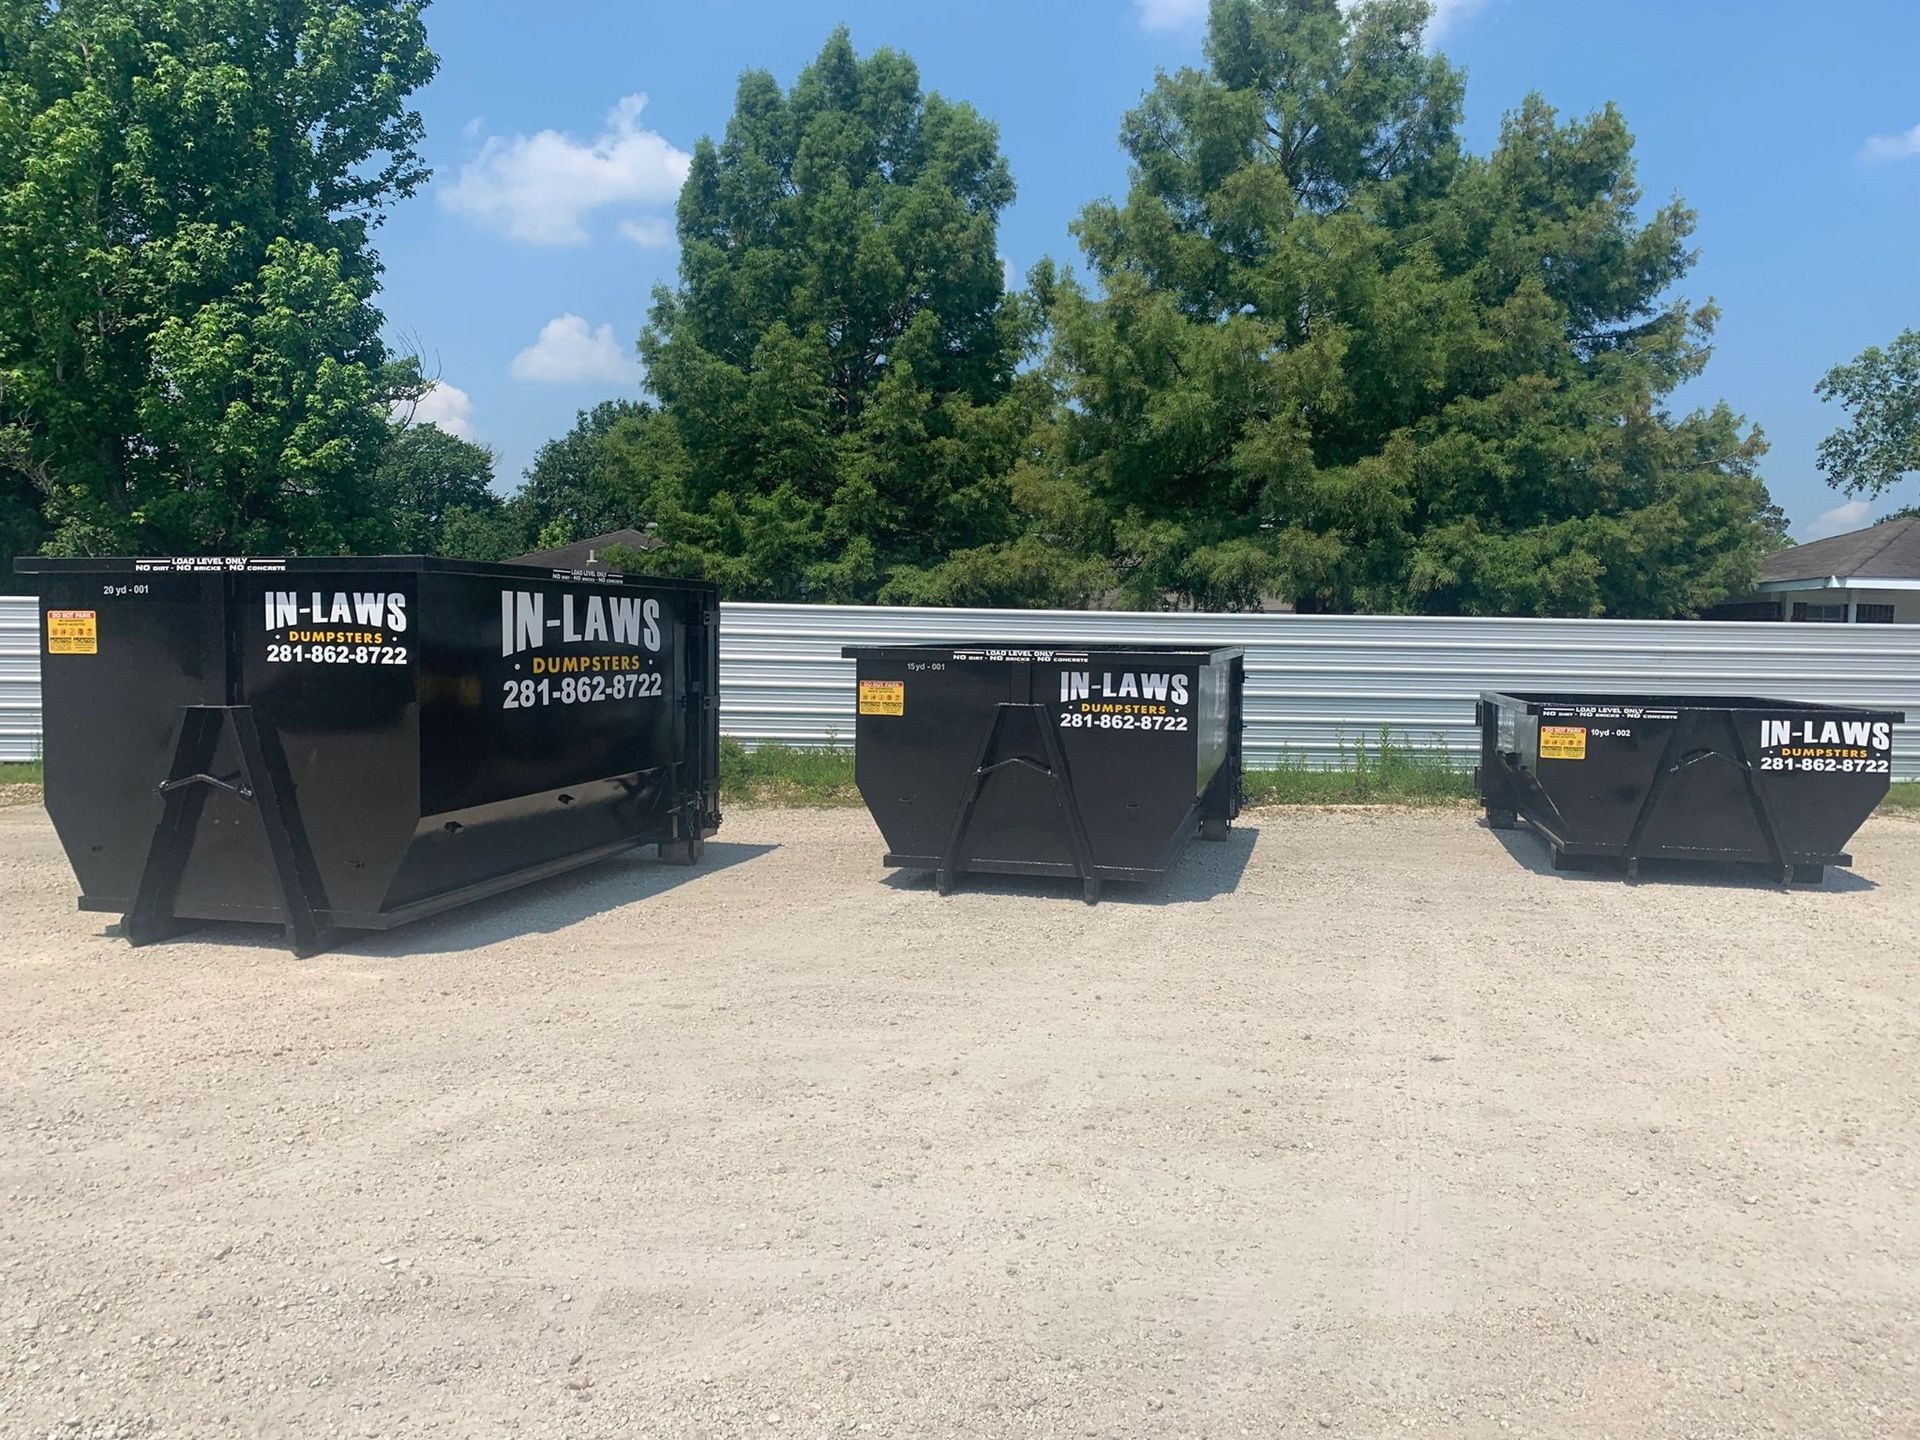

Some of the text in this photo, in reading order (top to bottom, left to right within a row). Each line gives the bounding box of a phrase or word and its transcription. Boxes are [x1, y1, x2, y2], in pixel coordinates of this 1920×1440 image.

[226, 557, 247, 565] ONLY
[103, 585, 114, 595] 20
[116, 585, 126, 596] yd
[134, 585, 149, 594] 001
[265, 591, 407, 632] IN-LAWS
[501, 590, 661, 658] IN-LAWS
[289, 631, 383, 644] DUMPSTERS
[266, 644, 407, 664] 281-862-8722
[532, 655, 640, 674] DUMPSTERS
[502, 672, 662, 709] 281-862-8722
[1060, 671, 1189, 706] IN-LAWS
[1081, 703, 1167, 715] DUMPSTERS
[1060, 713, 1188, 731] 281-862-8722
[1591, 729, 1610, 738] 10yd
[1761, 720, 1890, 750] IN-LAWS
[1782, 748, 1868, 758] DUMPSTERS
[1760, 757, 1889, 773] 281-862-8722
